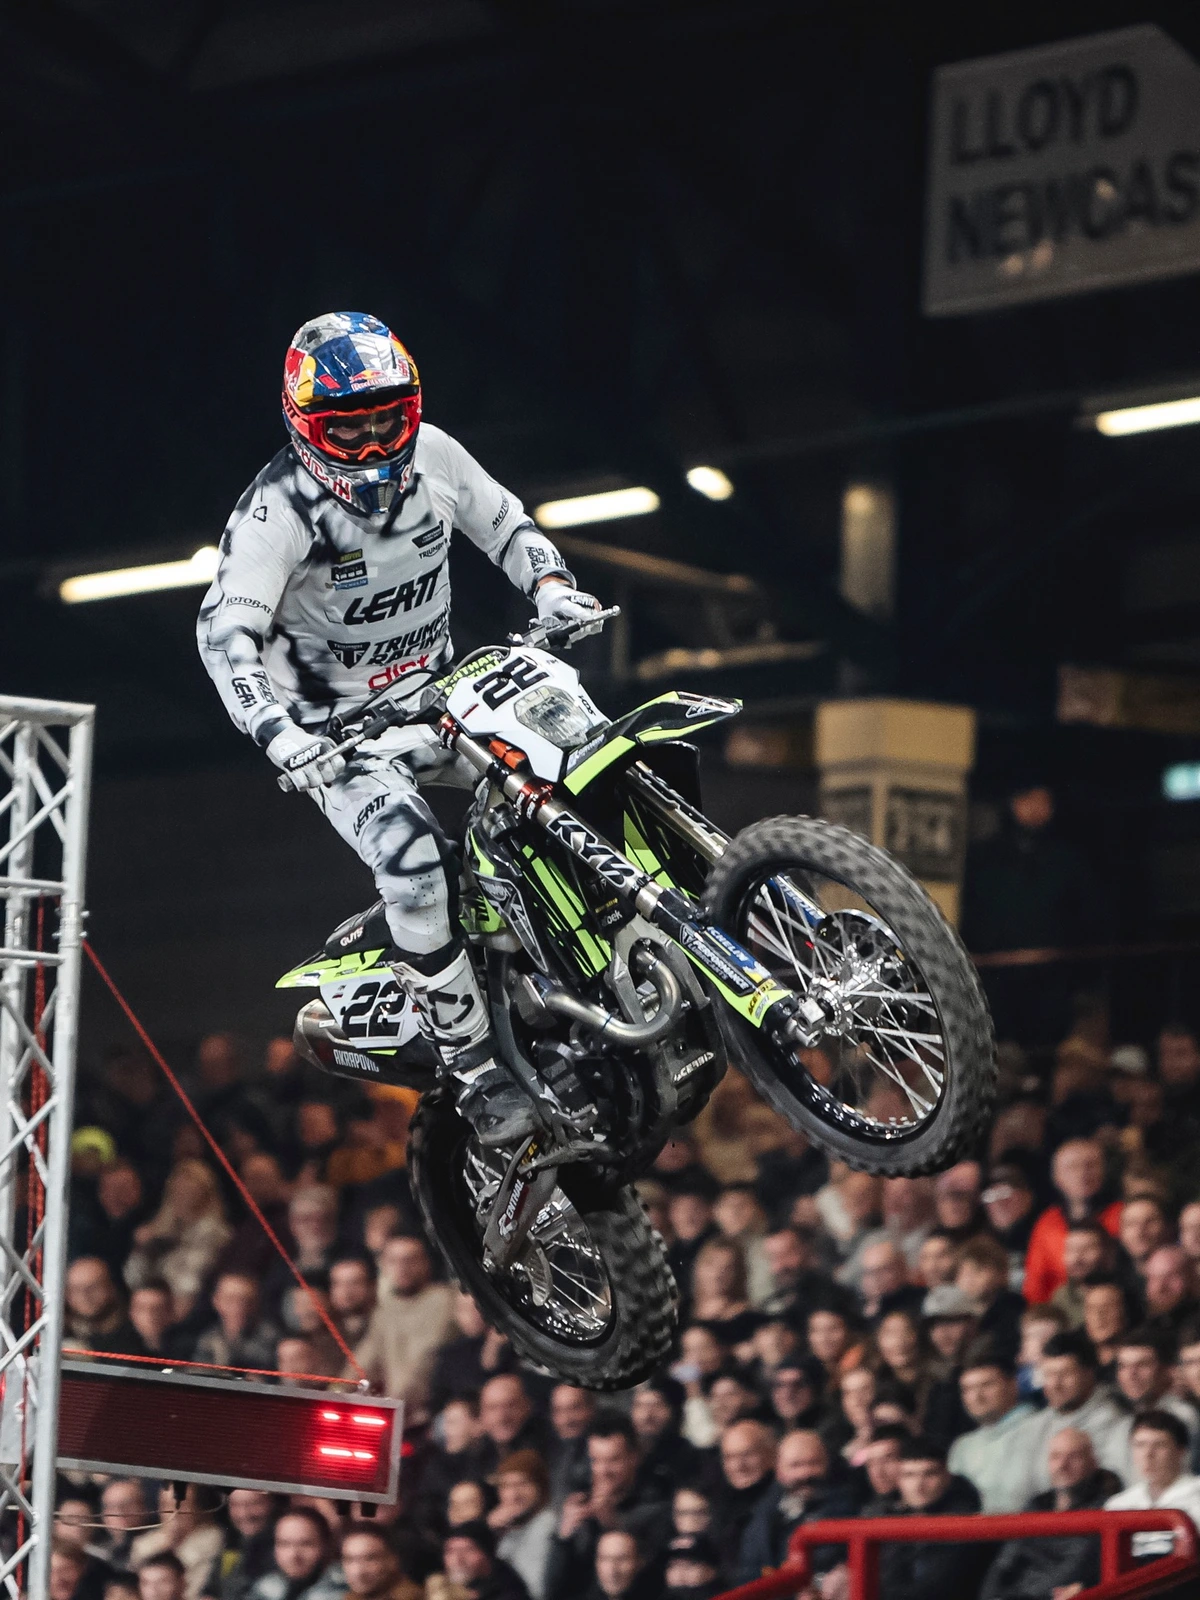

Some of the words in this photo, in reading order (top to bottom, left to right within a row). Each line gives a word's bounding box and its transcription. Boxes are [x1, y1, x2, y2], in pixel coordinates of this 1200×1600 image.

[953, 62, 1140, 165] LLOYD
[343, 564, 443, 625] LEATT
[472, 656, 550, 711] 22
[289, 743, 322, 768] LEATT
[353, 792, 391, 836] LEATT
[340, 926, 363, 947] GUTS
[707, 926, 748, 962] ICHELIN
[693, 939, 749, 991] PERFORMANCE
[340, 980, 408, 1039] 22
